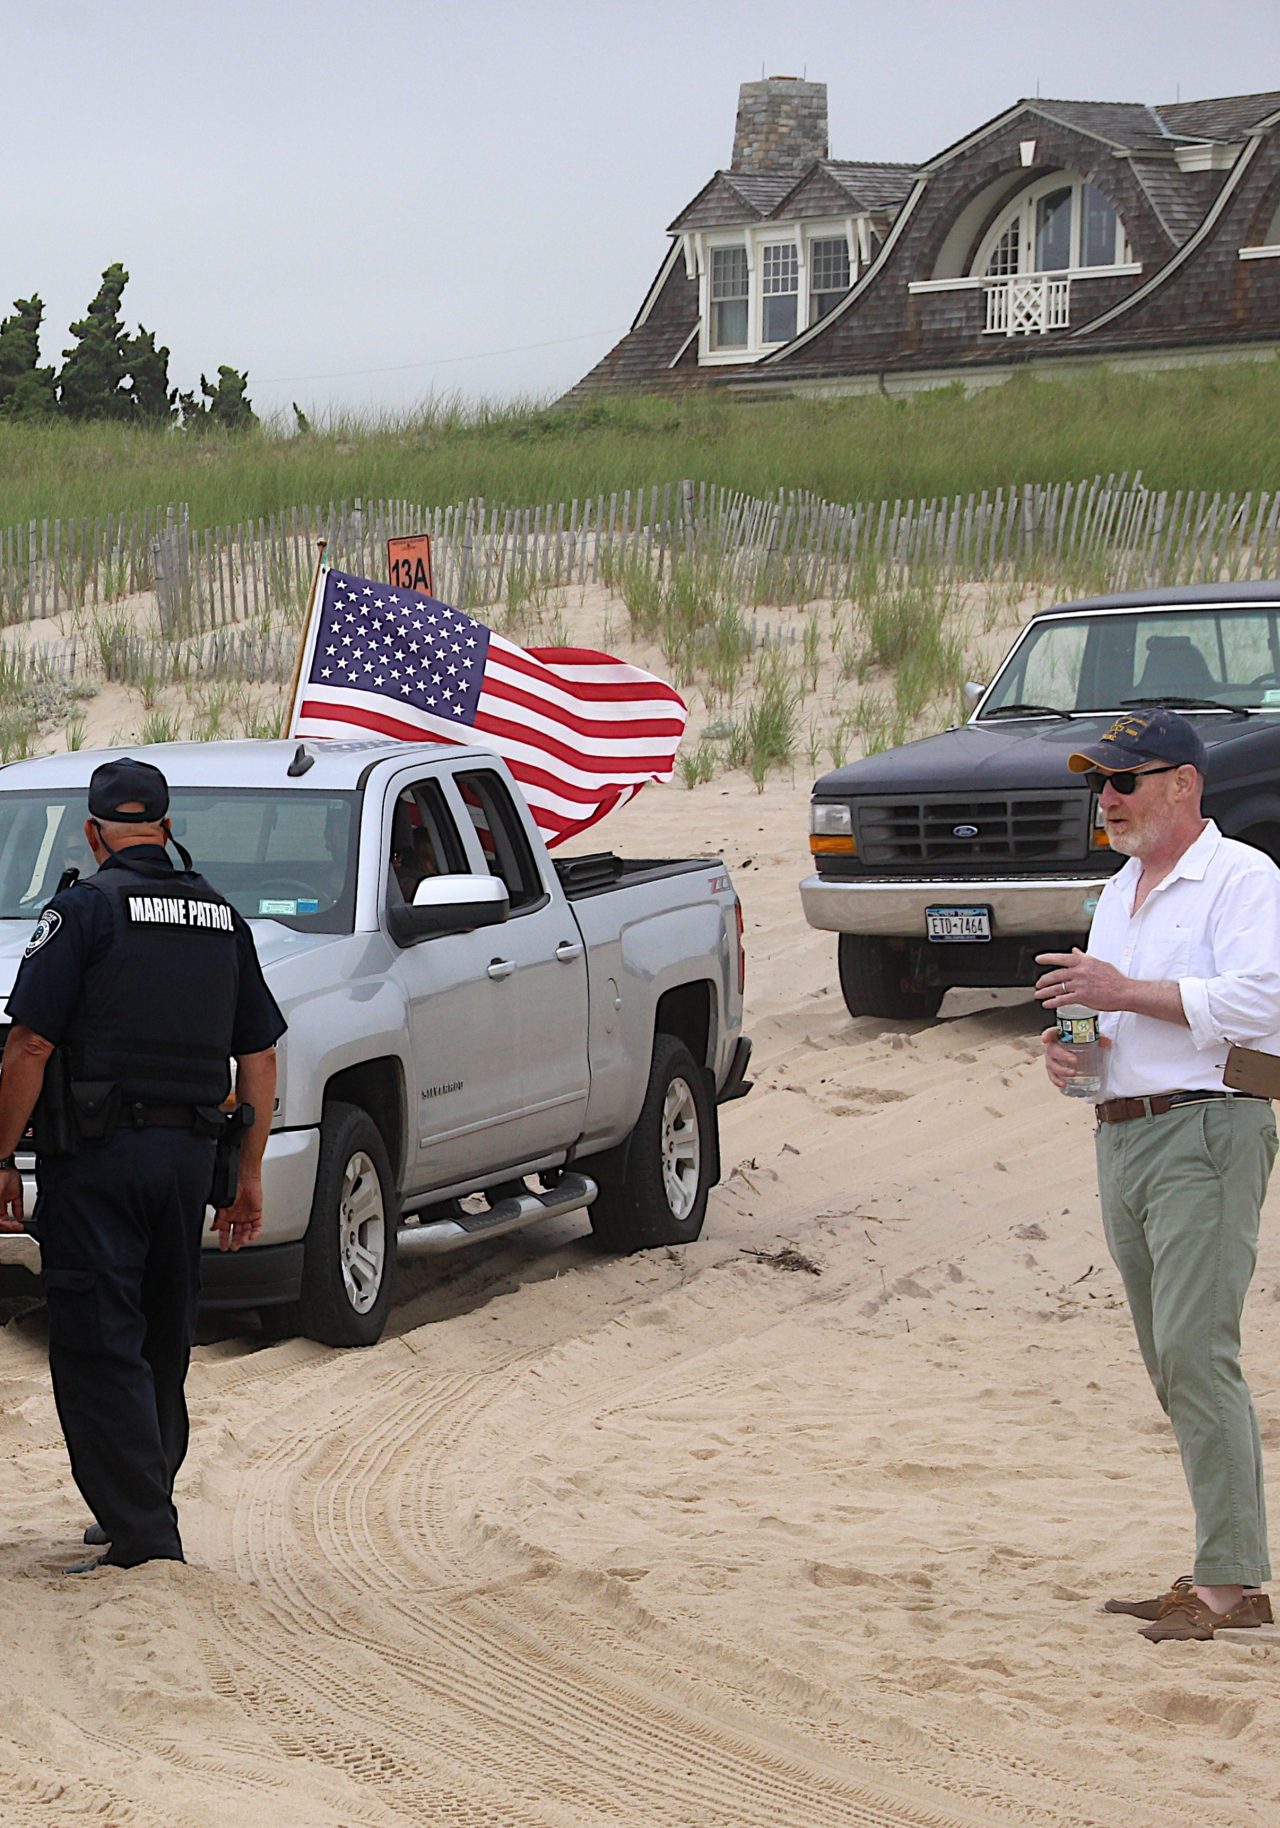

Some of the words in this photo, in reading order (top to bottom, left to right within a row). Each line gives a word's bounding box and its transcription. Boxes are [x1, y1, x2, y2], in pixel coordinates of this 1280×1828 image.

[391, 558, 429, 590] 13A
[128, 896, 187, 925] MARINE
[187, 900, 235, 932] PATROL
[958, 918, 984, 934] 7464
